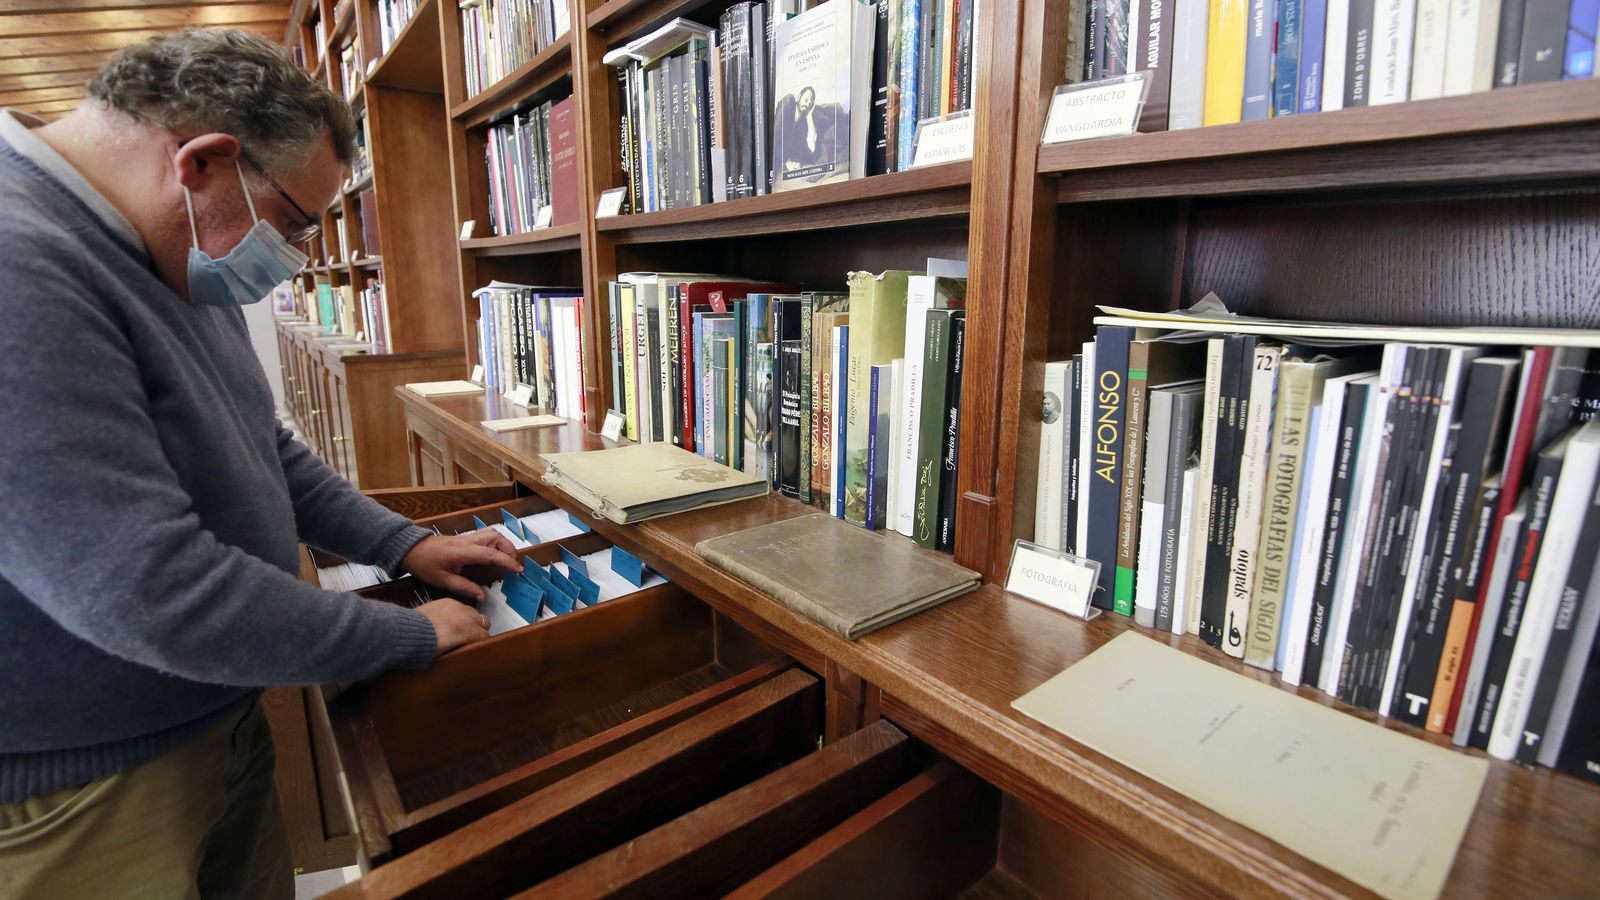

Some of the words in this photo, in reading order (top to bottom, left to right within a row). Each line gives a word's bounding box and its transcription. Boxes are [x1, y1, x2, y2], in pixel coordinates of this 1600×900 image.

[1254, 8, 1264, 37] mario
[1148, 20, 1161, 68] AGUILAR
[1065, 89, 1126, 108] ABSTRACTO
[1353, 73, 1364, 101] ZONA
[933, 122, 969, 137] ESCUELAS
[1055, 117, 1122, 135] VANGUARDIA
[924, 144, 968, 159] ESPAÑOLAS
[510, 295, 518, 355] PICASSO
[516, 294, 525, 356] PICASSO
[637, 299, 646, 356] URGELL
[668, 297, 679, 363] MEIFREN
[659, 344, 667, 391] SOLANA
[849, 354, 857, 383] Lucas
[1257, 354, 1273, 371] 72
[908, 363, 917, 408] PRADILLA
[849, 389, 858, 426] Eugenio
[947, 406, 958, 435] Pradilla
[1130, 402, 1140, 424] Laurent
[905, 410, 913, 459] FRANCISCO
[1095, 370, 1120, 483] ALFONSO
[1282, 416, 1303, 446] LAS
[945, 436, 956, 471] Francisco
[1127, 440, 1137, 468] Fotografías
[1126, 469, 1134, 477] las
[1123, 500, 1132, 511] Siglo
[1264, 453, 1299, 561] FOTOGRAFIAS
[1121, 522, 1130, 549] Andalucía
[1161, 528, 1174, 572] FOTOGRAFÍA
[1021, 567, 1078, 593] FOTOGRAFIA
[1160, 573, 1169, 584] DE
[1233, 549, 1248, 599] spafoto
[1261, 566, 1283, 593] DEL
[1158, 586, 1169, 604] AÑOS
[1158, 607, 1168, 618] 175
[1200, 620, 1206, 629] 2
[1254, 600, 1278, 642] SIGLO
[1209, 625, 1214, 633] 1
[1405, 692, 1429, 716] T
